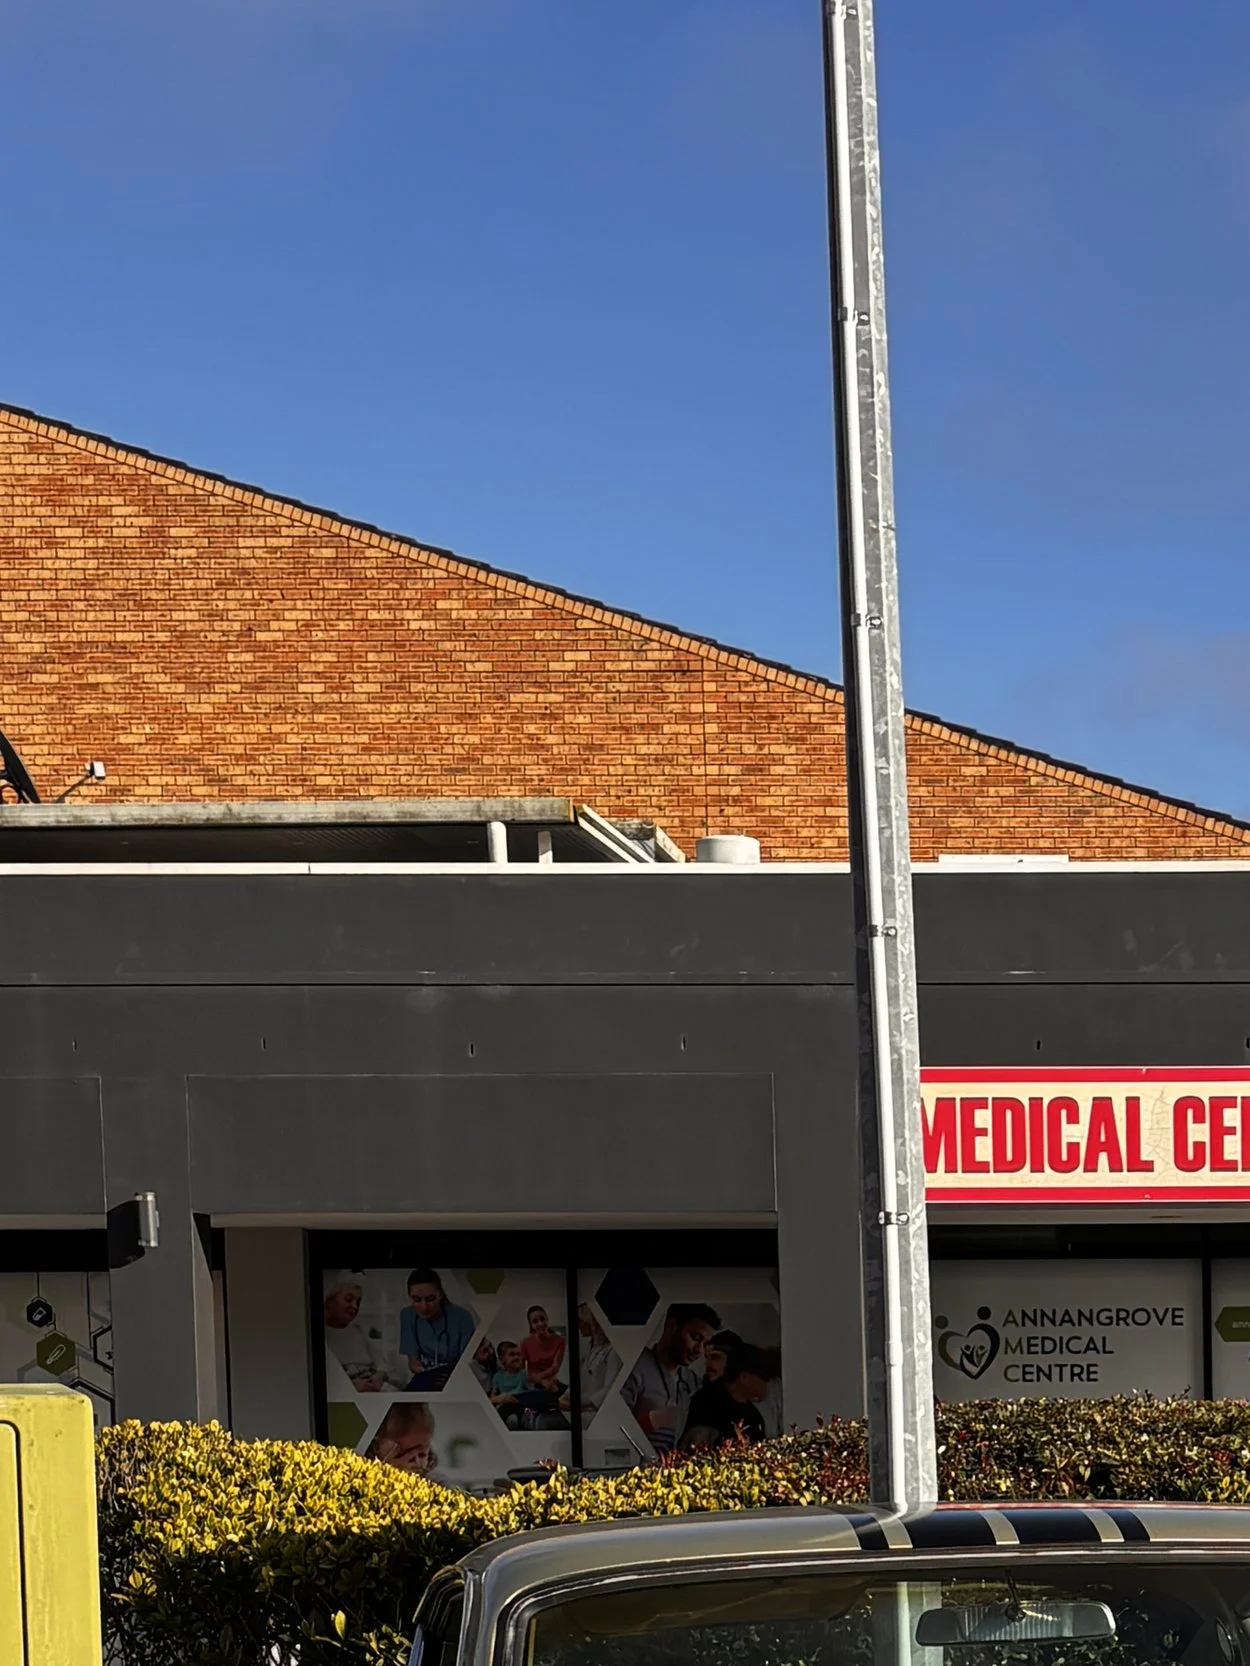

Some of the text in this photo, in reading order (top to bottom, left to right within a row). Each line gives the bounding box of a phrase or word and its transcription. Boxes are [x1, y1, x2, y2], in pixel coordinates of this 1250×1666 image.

[919, 1096, 1154, 1173] MEDICAL
[1002, 1307, 1185, 1328] ANNANGROVE
[1004, 1336, 1115, 1355] MEDICAL
[1003, 1363, 1099, 1382] CENTRE
